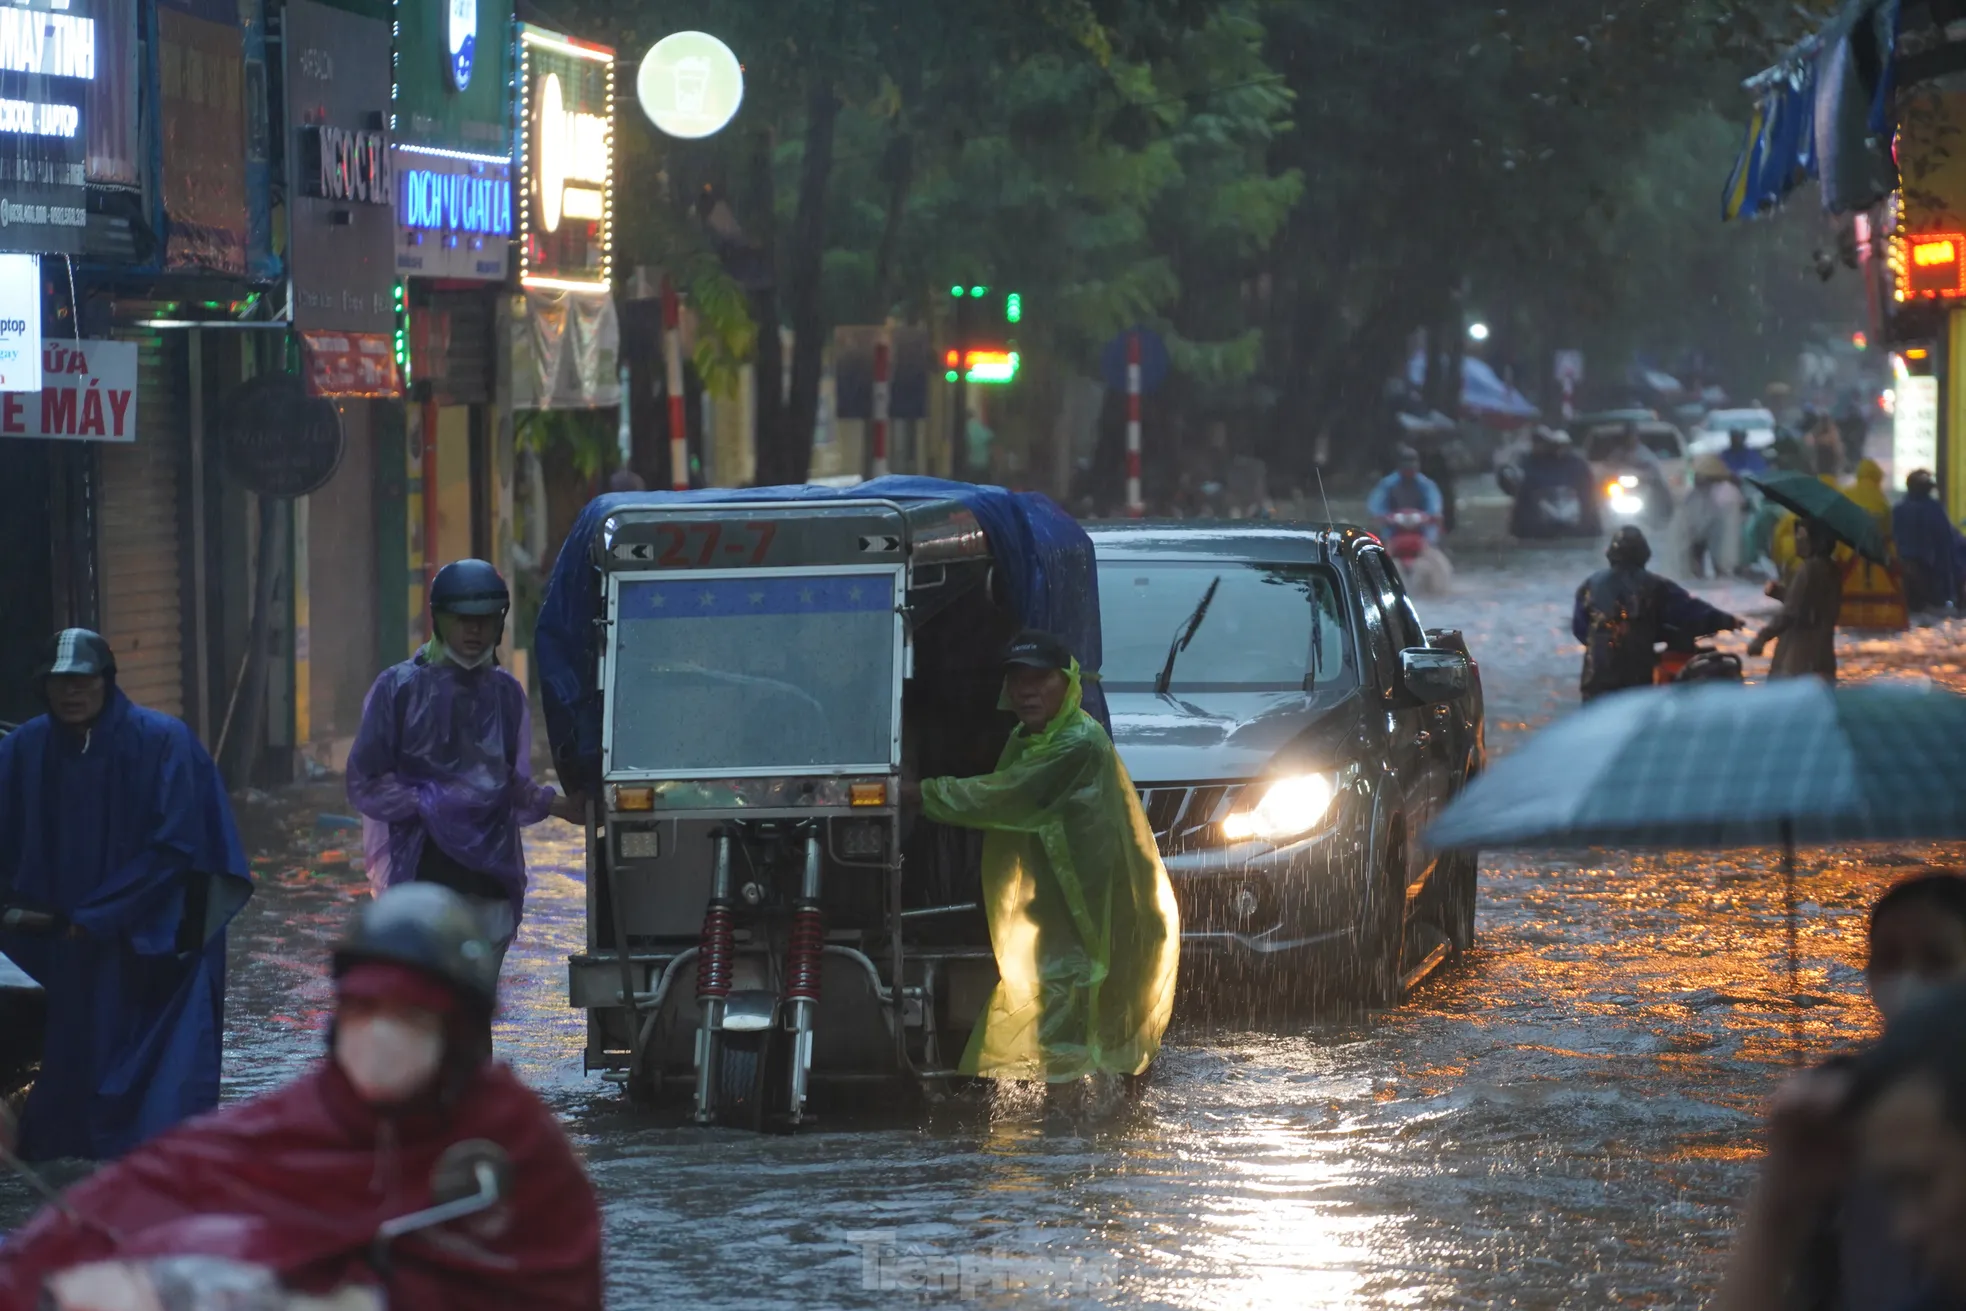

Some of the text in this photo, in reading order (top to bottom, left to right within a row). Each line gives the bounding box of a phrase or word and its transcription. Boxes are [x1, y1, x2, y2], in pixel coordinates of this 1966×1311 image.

[40, 103, 78, 137] LAPTOP
[41, 377, 132, 437] MÁY
[655, 521, 777, 567] 27-7
